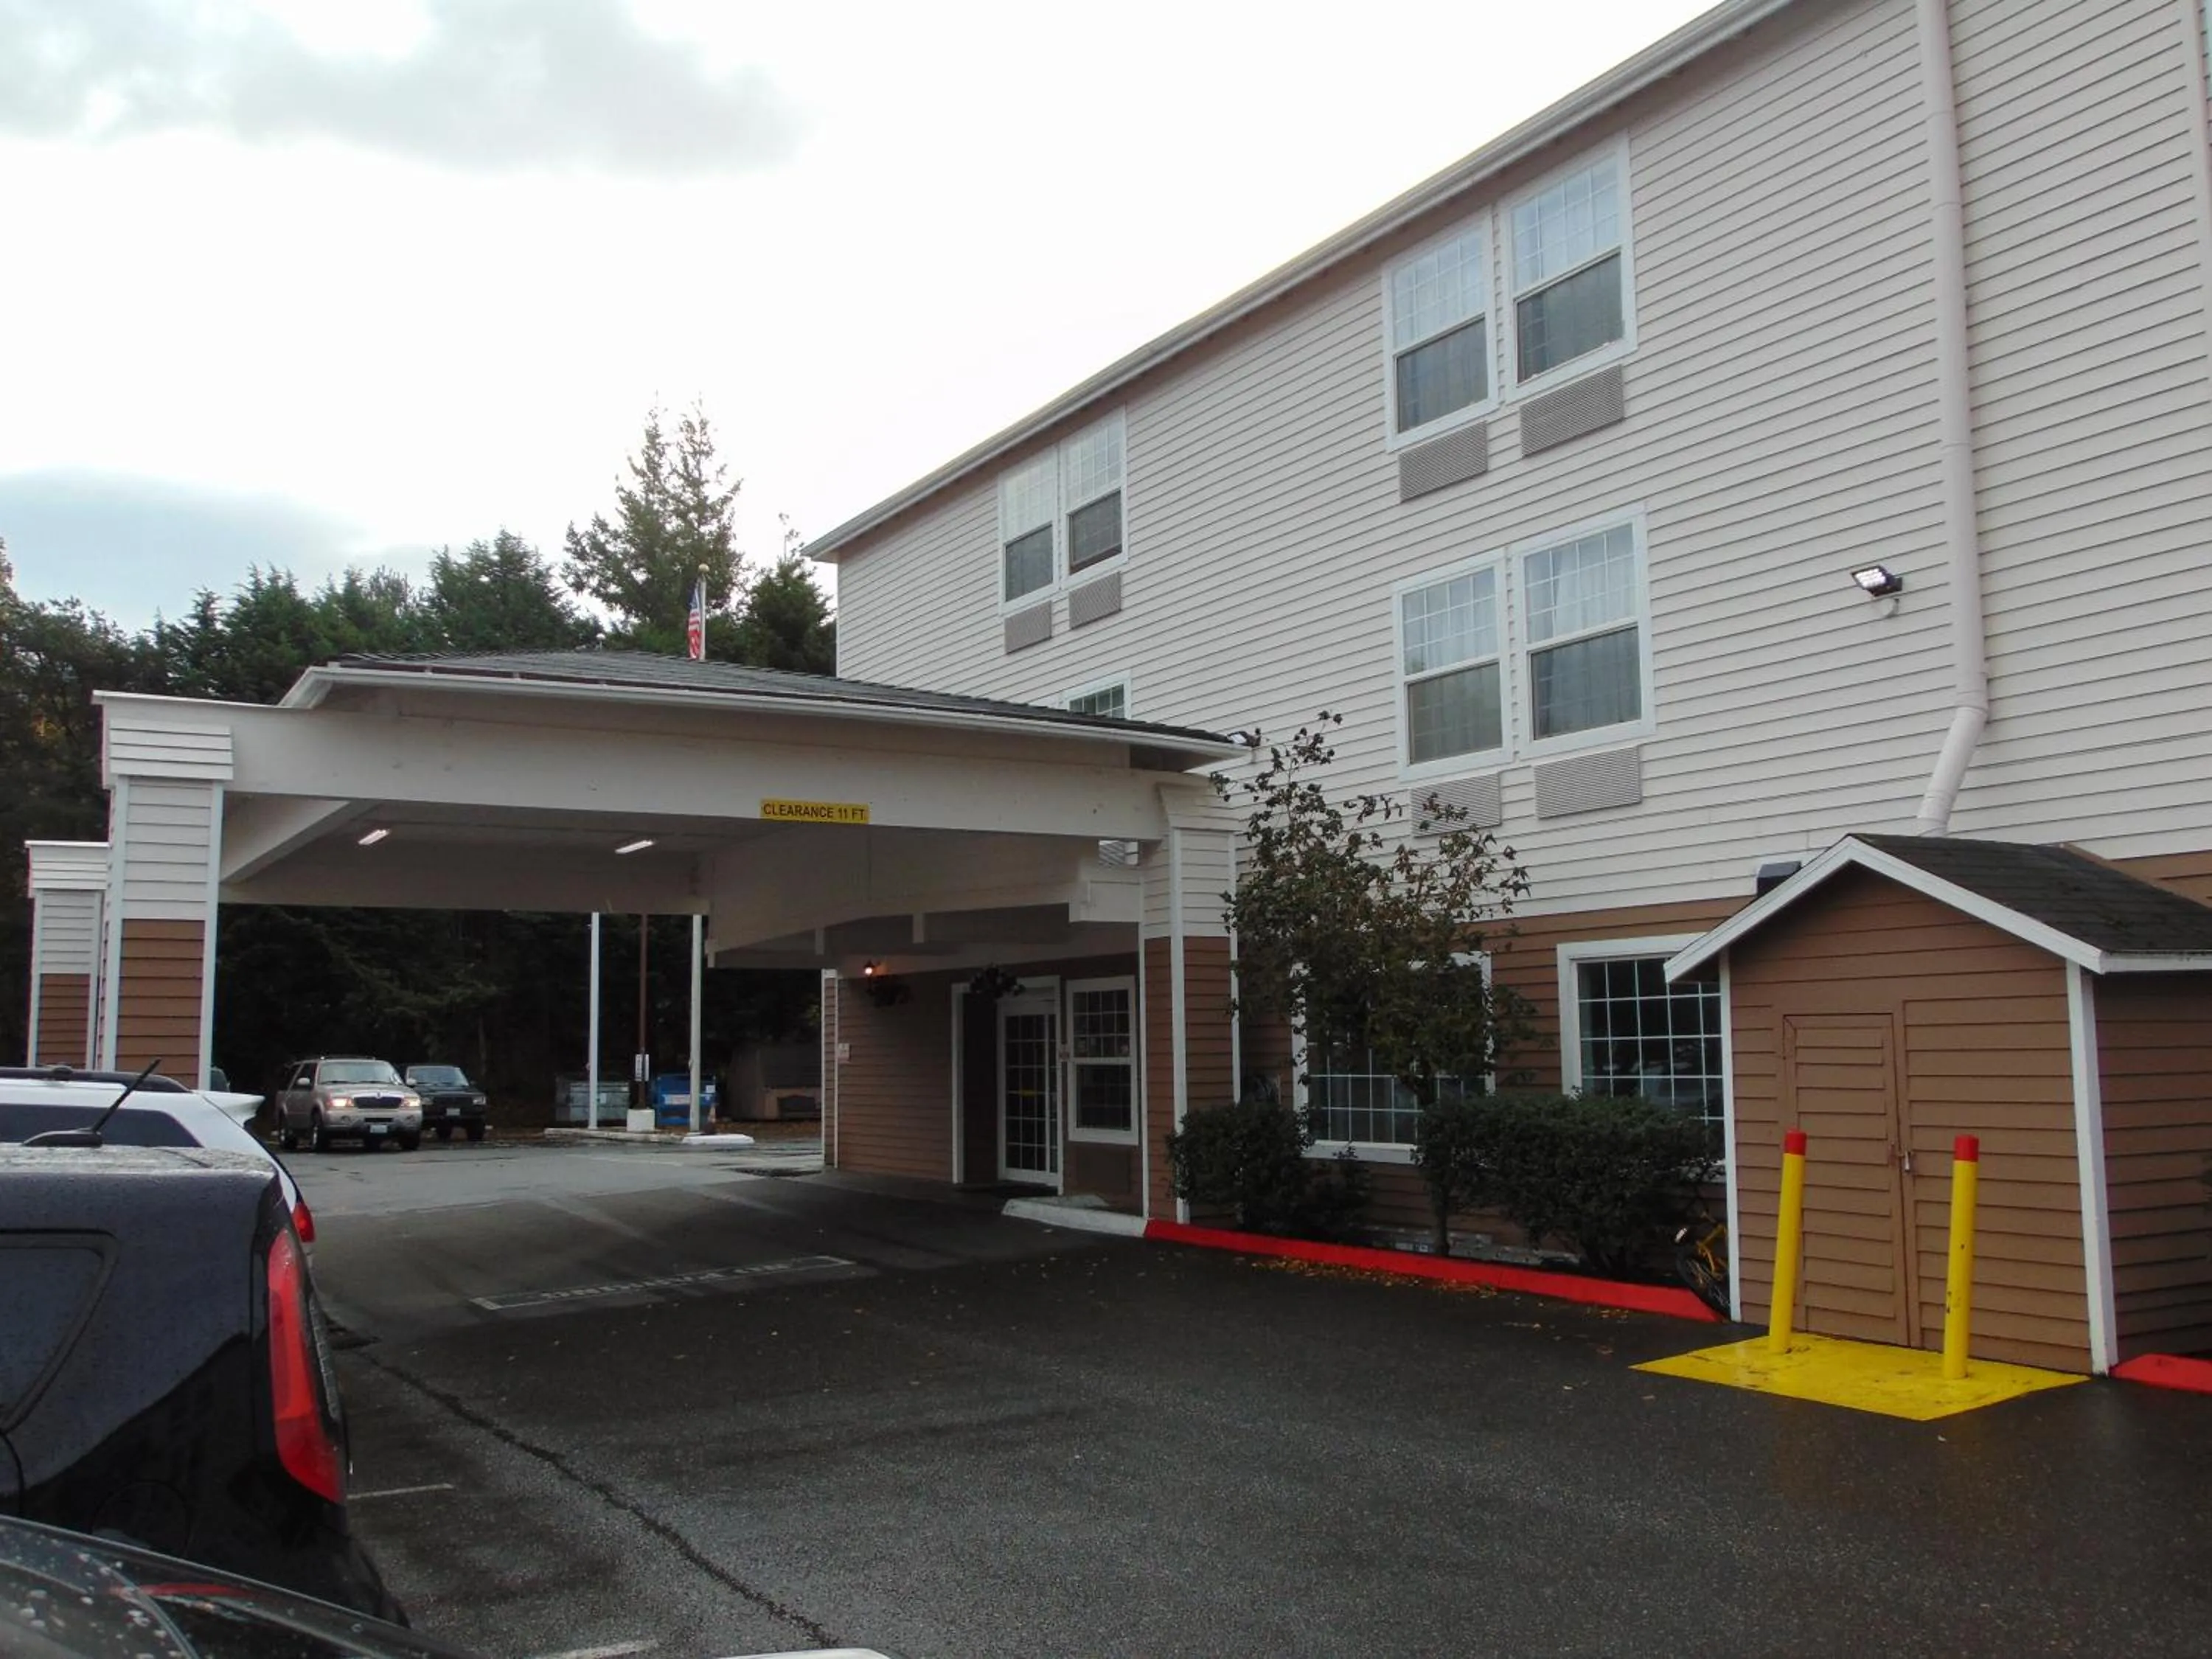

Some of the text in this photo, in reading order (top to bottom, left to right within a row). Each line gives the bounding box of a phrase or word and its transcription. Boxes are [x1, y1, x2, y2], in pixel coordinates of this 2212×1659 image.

[763, 803, 865, 820] CLEARANCE 11 FT
